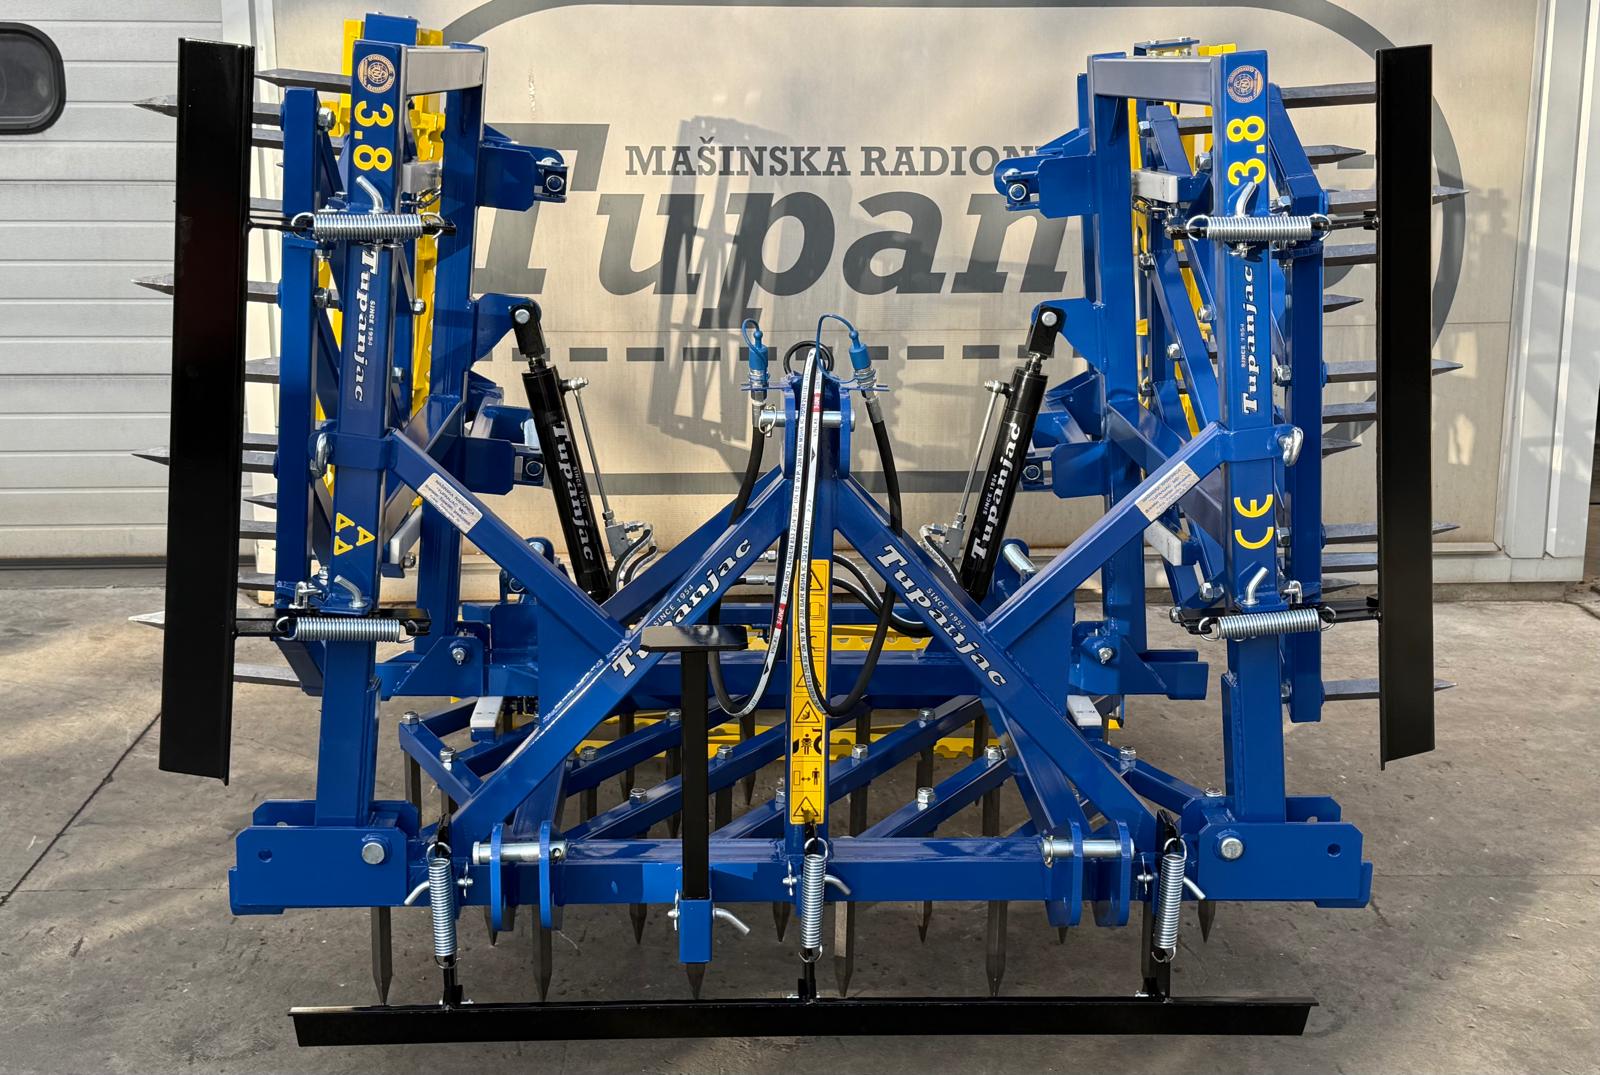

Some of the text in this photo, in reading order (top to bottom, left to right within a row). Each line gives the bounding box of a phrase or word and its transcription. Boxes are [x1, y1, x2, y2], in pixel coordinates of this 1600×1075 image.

[353, 100, 394, 171] 3.8
[625, 136, 851, 176] MAŠINSKA
[1226, 115, 1266, 186] 3.8
[353, 250, 379, 402] Tupanjac
[1242, 266, 1260, 414] Tupanjac
[552, 420, 593, 560] Tupanjac
[971, 422, 1020, 560] Tupanjac
[983, 493, 993, 515] SINCE
[1233, 494, 1274, 550] CE
[611, 539, 751, 678] Tanjac
[653, 585, 694, 626] SINCE 1954
[877, 545, 1007, 686] Tupanjac
[926, 587, 967, 630] SINCE 1954
